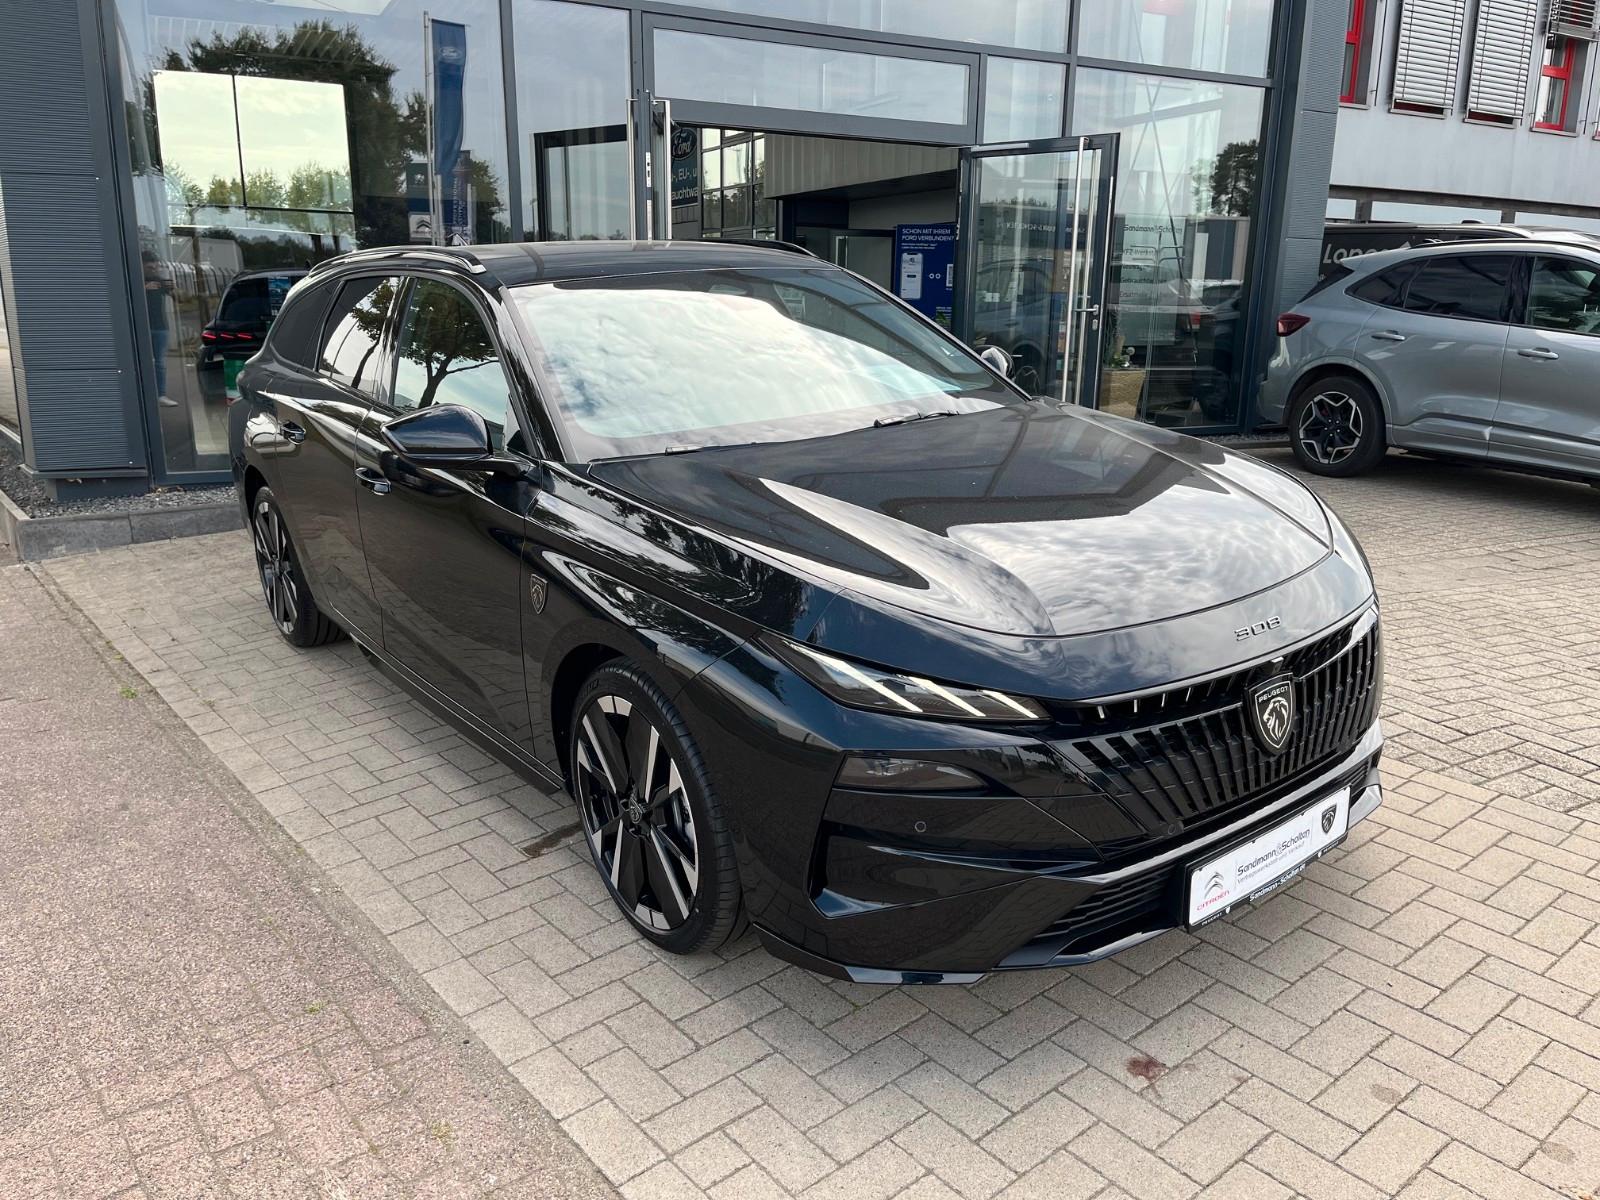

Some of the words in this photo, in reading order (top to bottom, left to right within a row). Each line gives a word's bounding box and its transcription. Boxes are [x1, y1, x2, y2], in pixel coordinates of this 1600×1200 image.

[671, 187, 698, 200] auchtwa
[1235, 616, 1281, 641] 308
[1258, 686, 1289, 702] PEUGEOT
